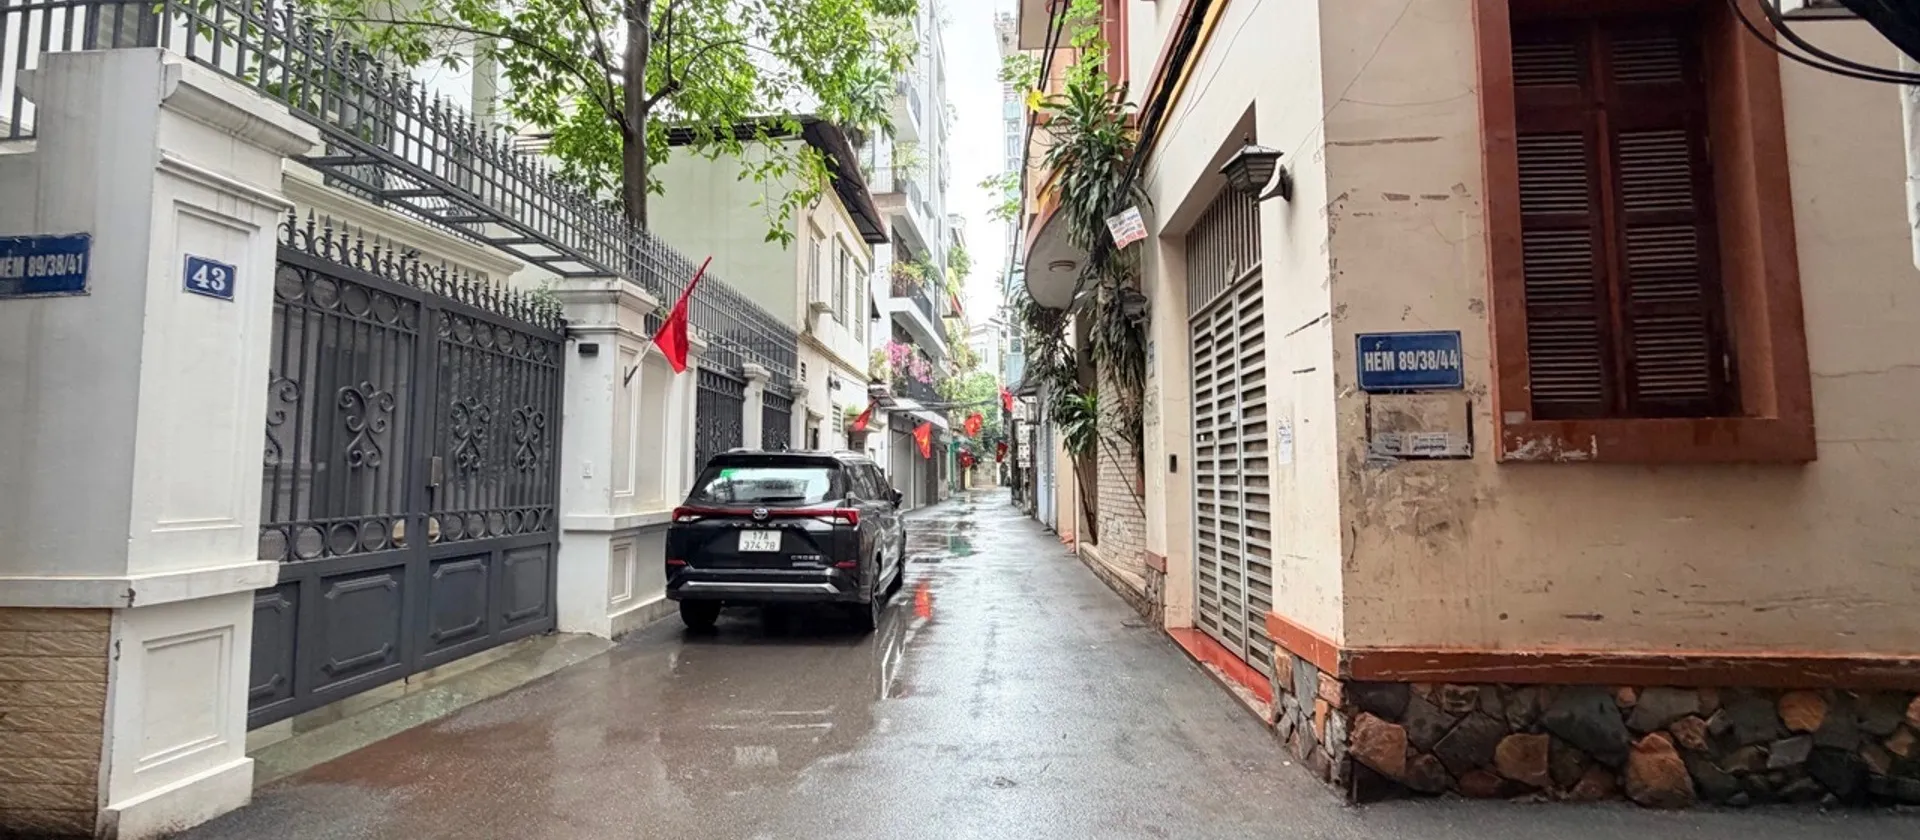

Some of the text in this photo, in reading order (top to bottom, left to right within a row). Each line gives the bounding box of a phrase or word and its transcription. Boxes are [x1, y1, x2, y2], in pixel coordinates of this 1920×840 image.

[28, 253, 83, 278] 89/38/41
[192, 264, 226, 291] 43
[1398, 349, 1459, 371] 89/38/44
[753, 531, 769, 541] 17A
